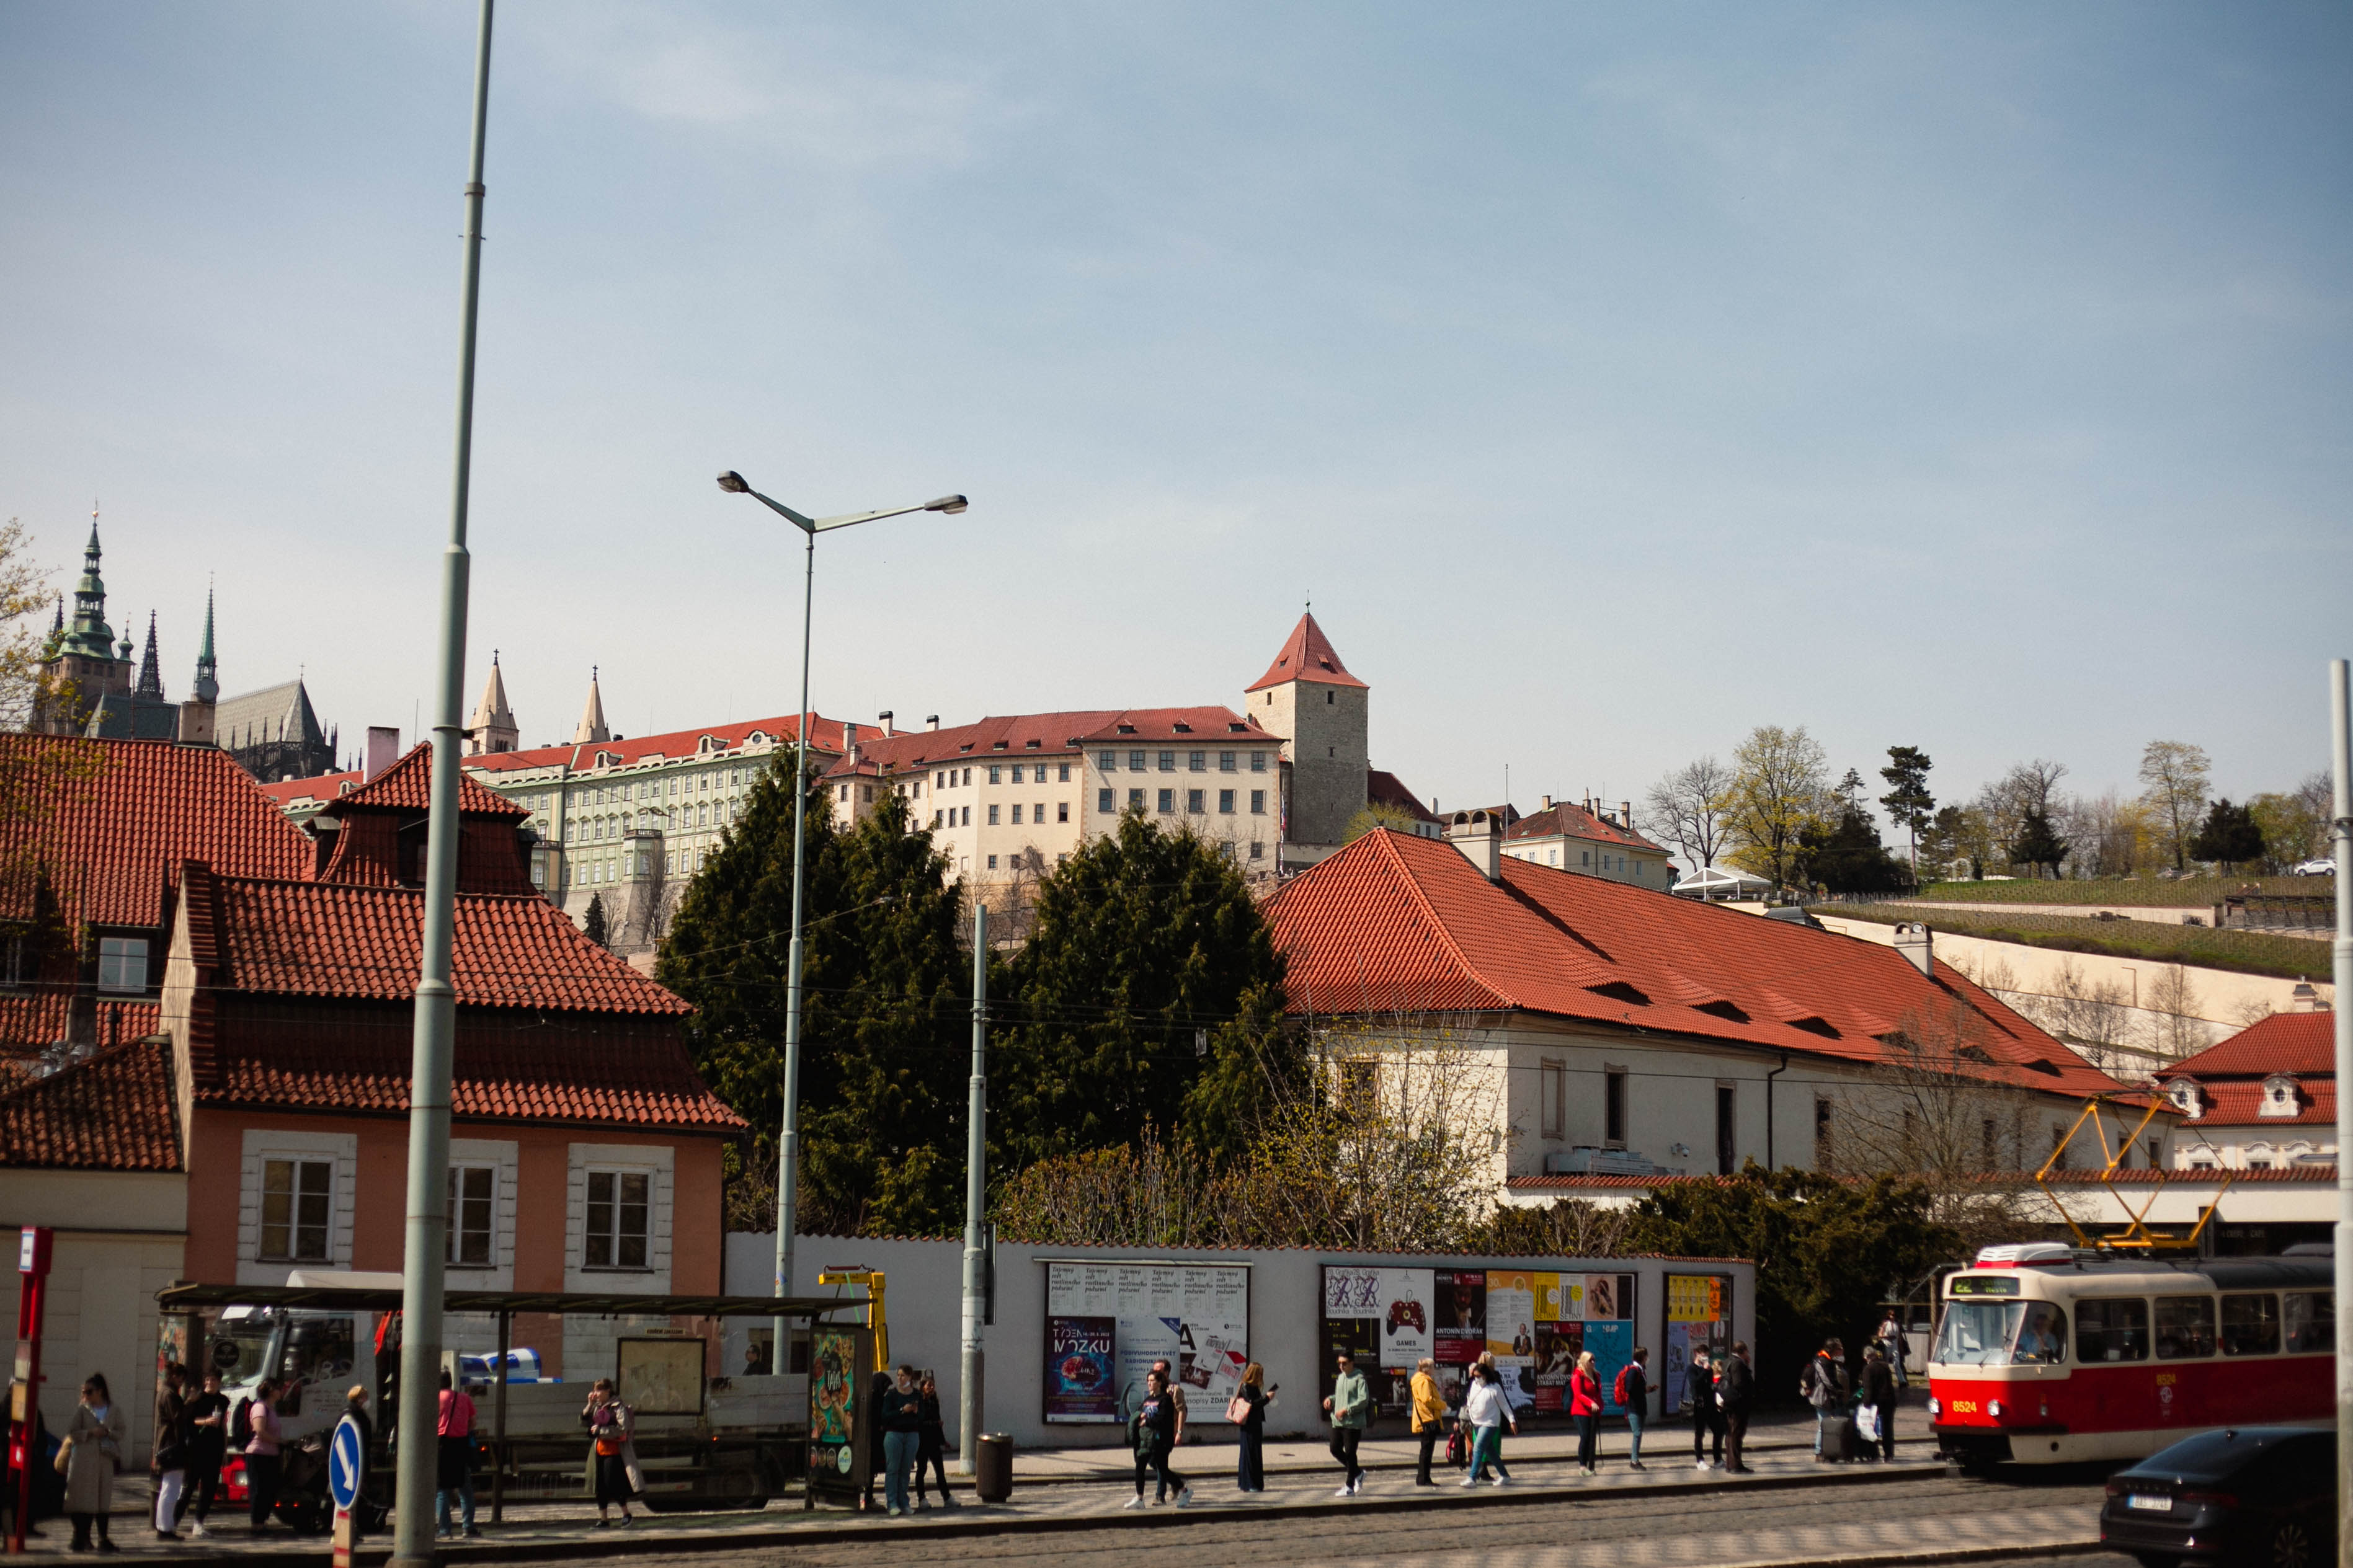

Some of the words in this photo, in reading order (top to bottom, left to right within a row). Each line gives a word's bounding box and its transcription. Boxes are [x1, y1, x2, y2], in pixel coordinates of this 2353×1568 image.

[1488, 1278, 1501, 1288] 30.
[1054, 1339, 1110, 1353] MOZKU
[2156, 1374, 2176, 1386] 8524
[1952, 1400, 1978, 1413] 8524
